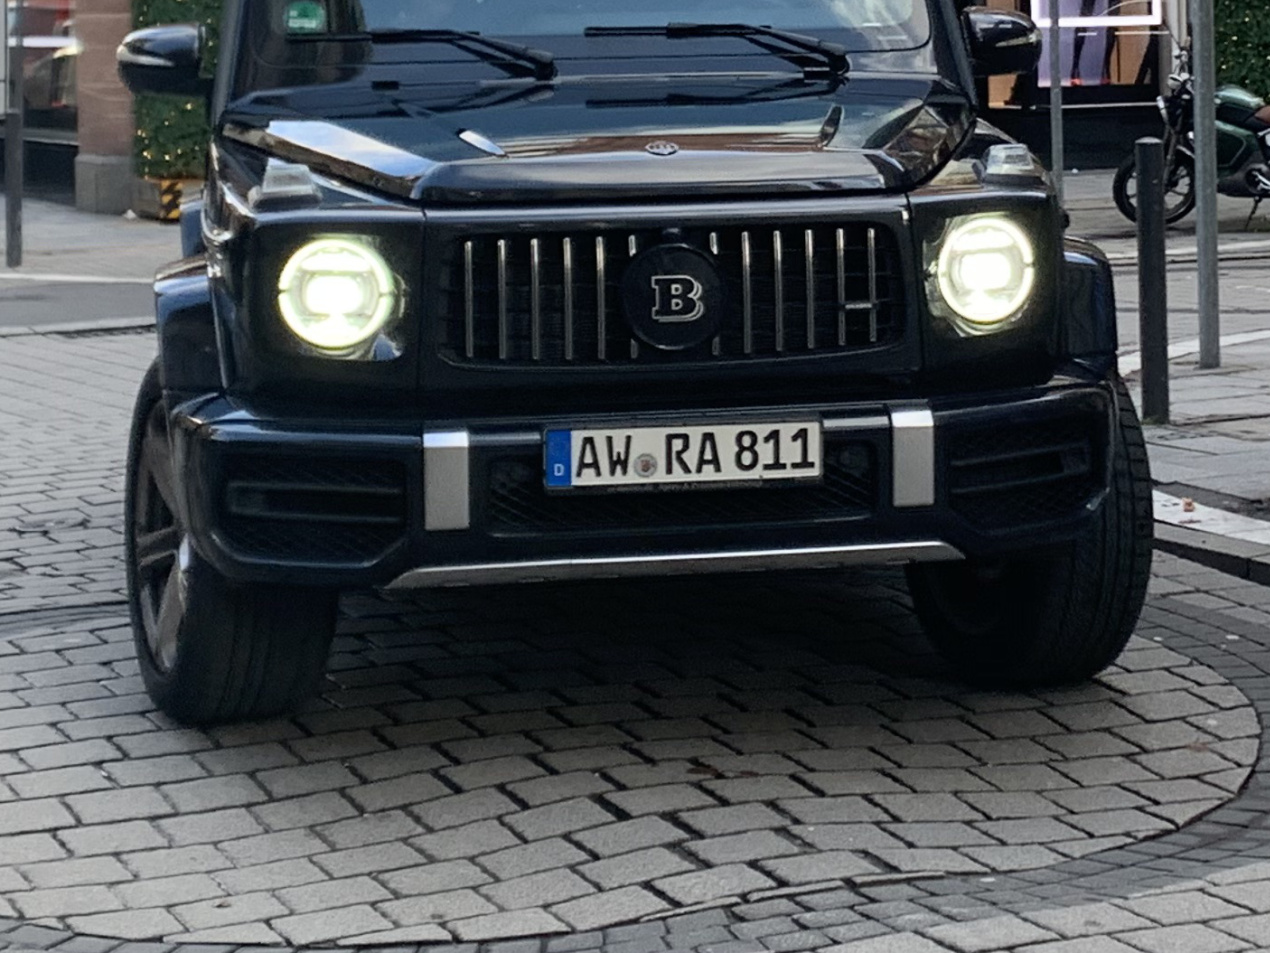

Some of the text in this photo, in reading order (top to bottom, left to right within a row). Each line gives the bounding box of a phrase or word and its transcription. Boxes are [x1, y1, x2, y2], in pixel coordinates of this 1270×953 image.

[576, 434, 632, 478] AW
[665, 431, 723, 475] RA
[734, 427, 816, 472] 811
